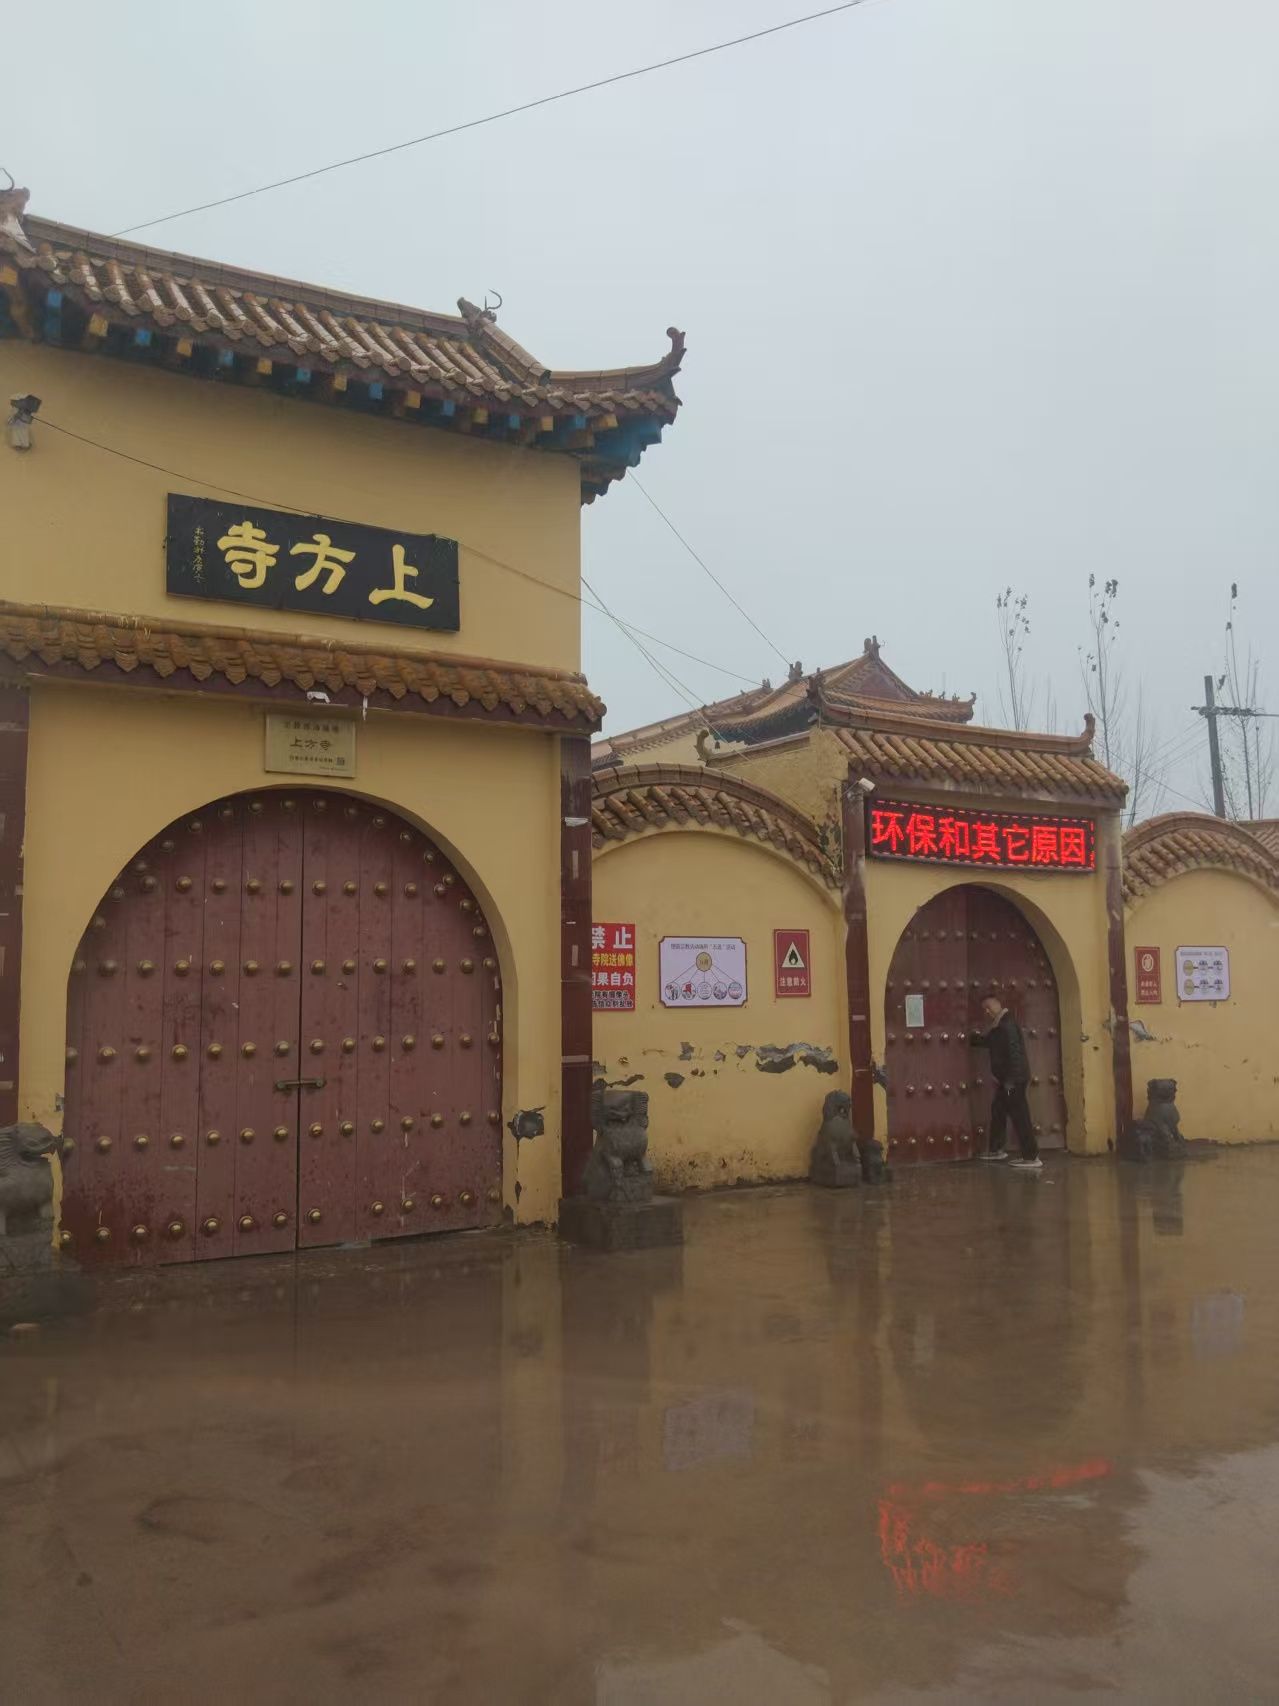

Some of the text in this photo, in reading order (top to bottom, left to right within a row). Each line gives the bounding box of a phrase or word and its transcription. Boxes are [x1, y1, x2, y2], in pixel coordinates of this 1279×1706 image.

[216, 520, 435, 610] 上方寺
[871, 809, 1087, 866] 环保和其它原因
[592, 925, 633, 949] 禁止
[779, 976, 807, 987] 注意防火
